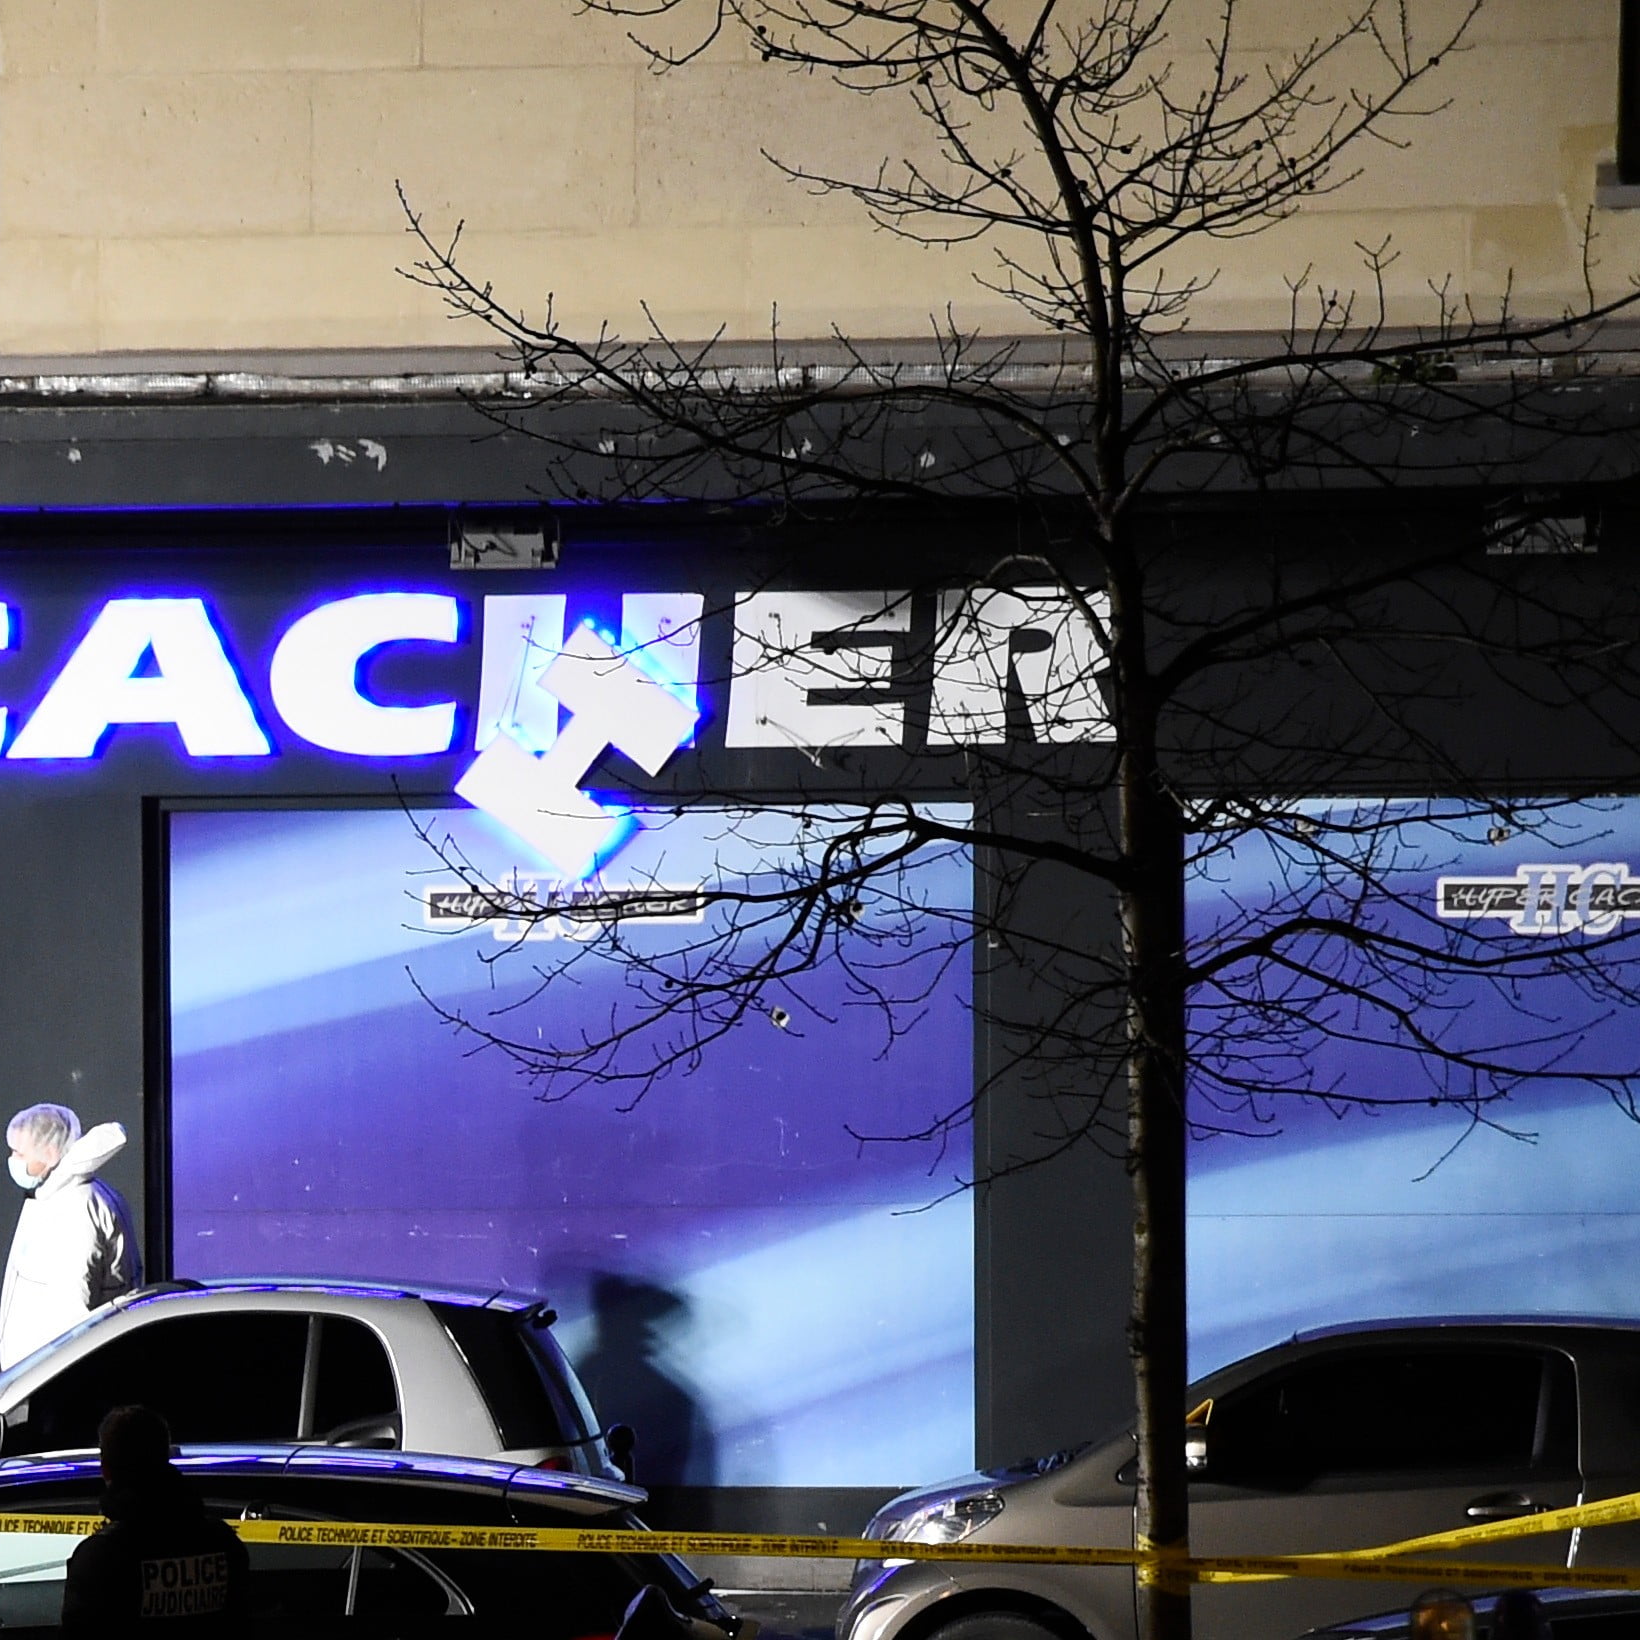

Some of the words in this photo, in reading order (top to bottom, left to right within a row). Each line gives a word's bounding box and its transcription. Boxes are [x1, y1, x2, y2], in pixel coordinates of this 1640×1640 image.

[23, 1519, 75, 1534] TECHNIQUE
[76, 1521, 89, 1535] ET
[279, 1525, 312, 1541] POLICE
[316, 1526, 368, 1543] TECHNIQUE
[370, 1529, 383, 1543] ET
[459, 1531, 484, 1546] ZONE
[487, 1532, 537, 1547] INTERDITE
[144, 1553, 226, 1590] POLICE
